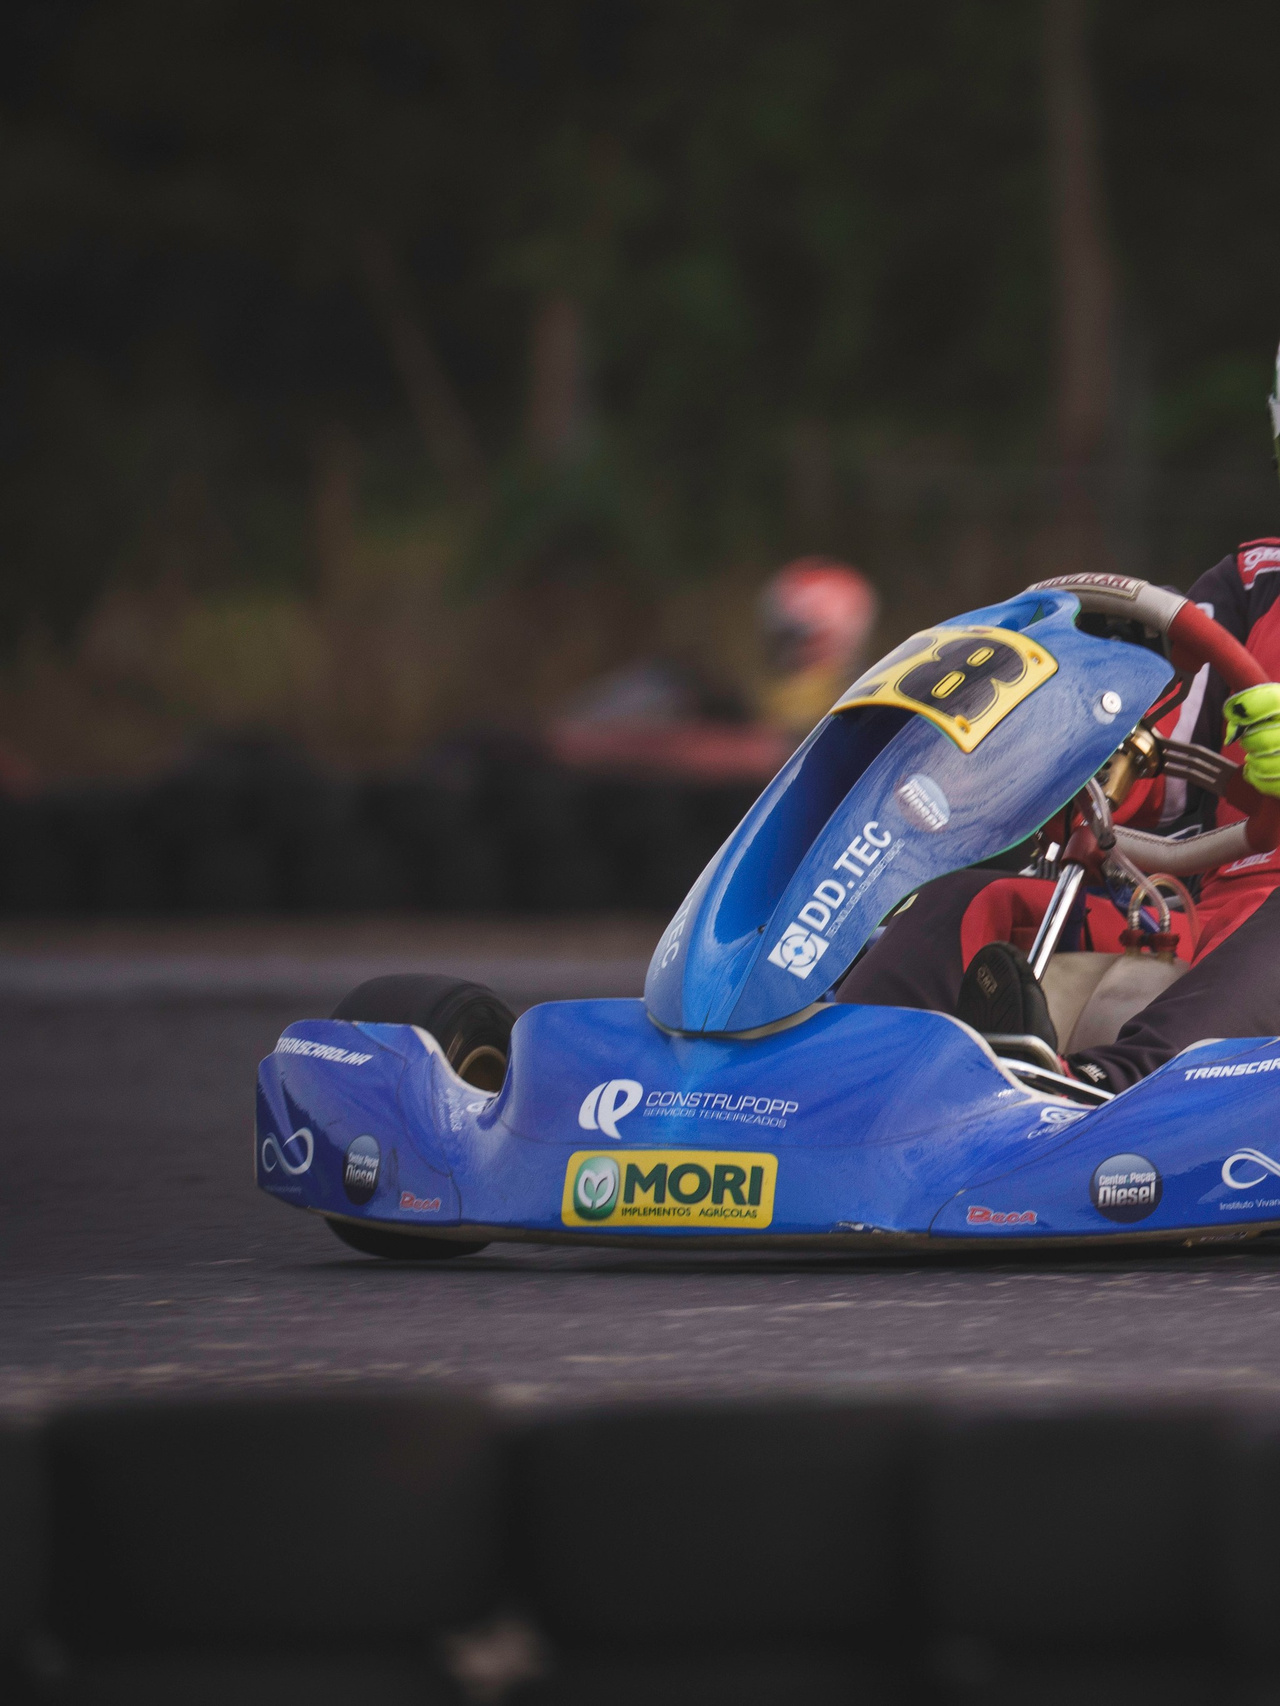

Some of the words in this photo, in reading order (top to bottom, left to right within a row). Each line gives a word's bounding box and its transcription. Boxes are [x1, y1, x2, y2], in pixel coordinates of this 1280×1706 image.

[798, 821, 892, 932] DD.TEC
[274, 1037, 374, 1066] TRANSCAROLINA
[645, 1090, 799, 1117] CONSTRUPOPP
[699, 1110, 788, 1130] TERCEIRIZADOS
[344, 1164, 377, 1189] Diesel
[622, 1162, 765, 1206] MORI
[1099, 1174, 1129, 1187] Center
[1129, 1171, 1157, 1185] Peças
[1098, 1181, 1156, 1208] Diesel
[1219, 1201, 1254, 1212] Instituto
[621, 1207, 691, 1217] IMPLEMENTOS
[698, 1206, 758, 1219] AGRÍCOLAS
